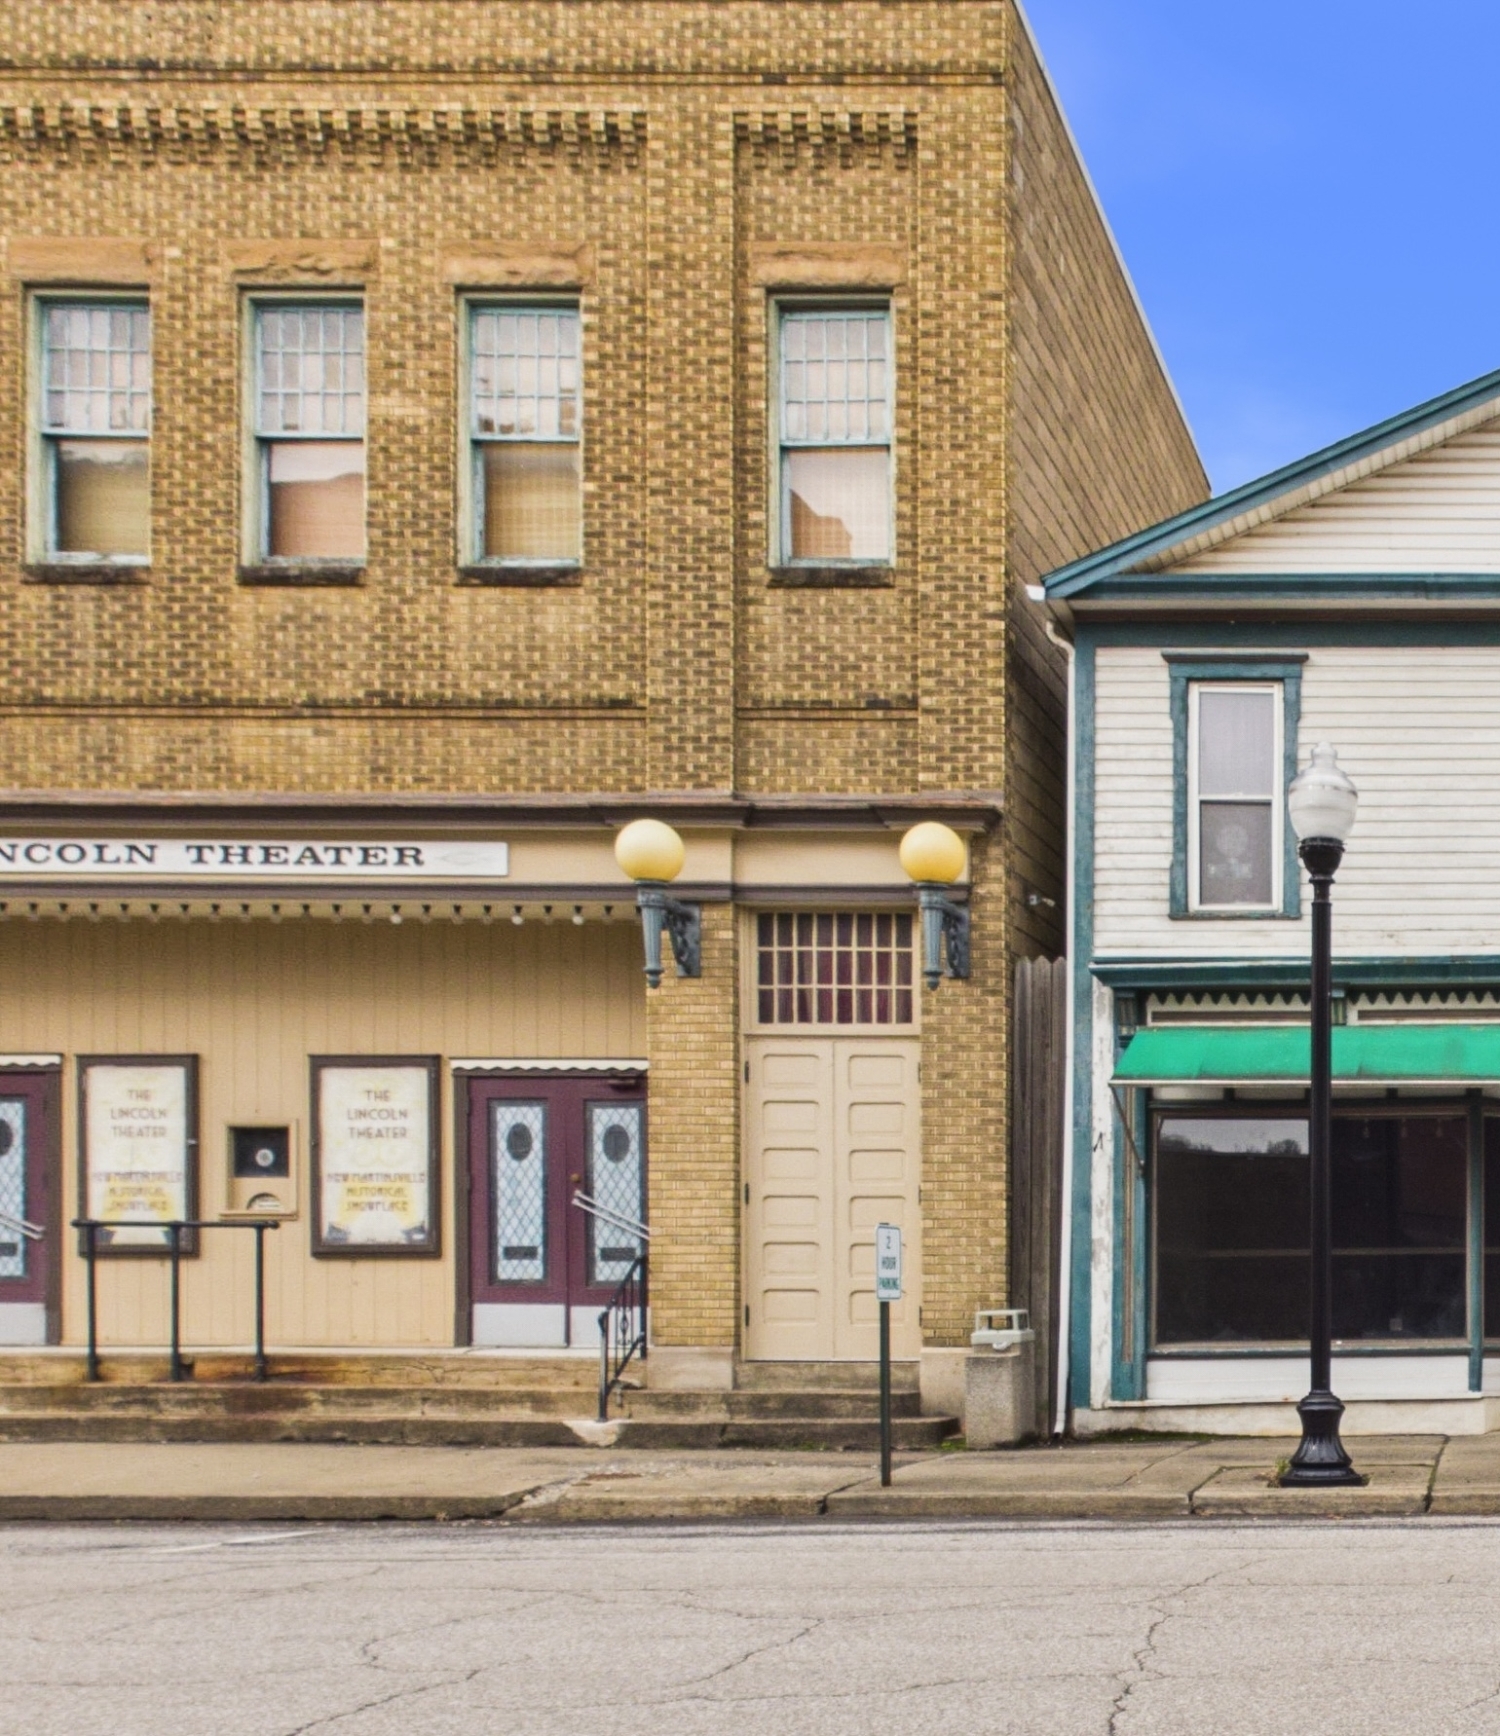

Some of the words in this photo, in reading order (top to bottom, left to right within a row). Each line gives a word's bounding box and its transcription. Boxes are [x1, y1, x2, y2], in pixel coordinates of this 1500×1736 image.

[185, 844, 426, 866] THEATER
[127, 1089, 150, 1100] THE
[365, 1090, 391, 1101] THE
[110, 1108, 167, 1119] LINCOLN
[347, 1109, 408, 1120] LINCOLN
[110, 1126, 167, 1138] THEATER
[348, 1127, 408, 1139] THEATER
[886, 1235, 891, 1249] 2
